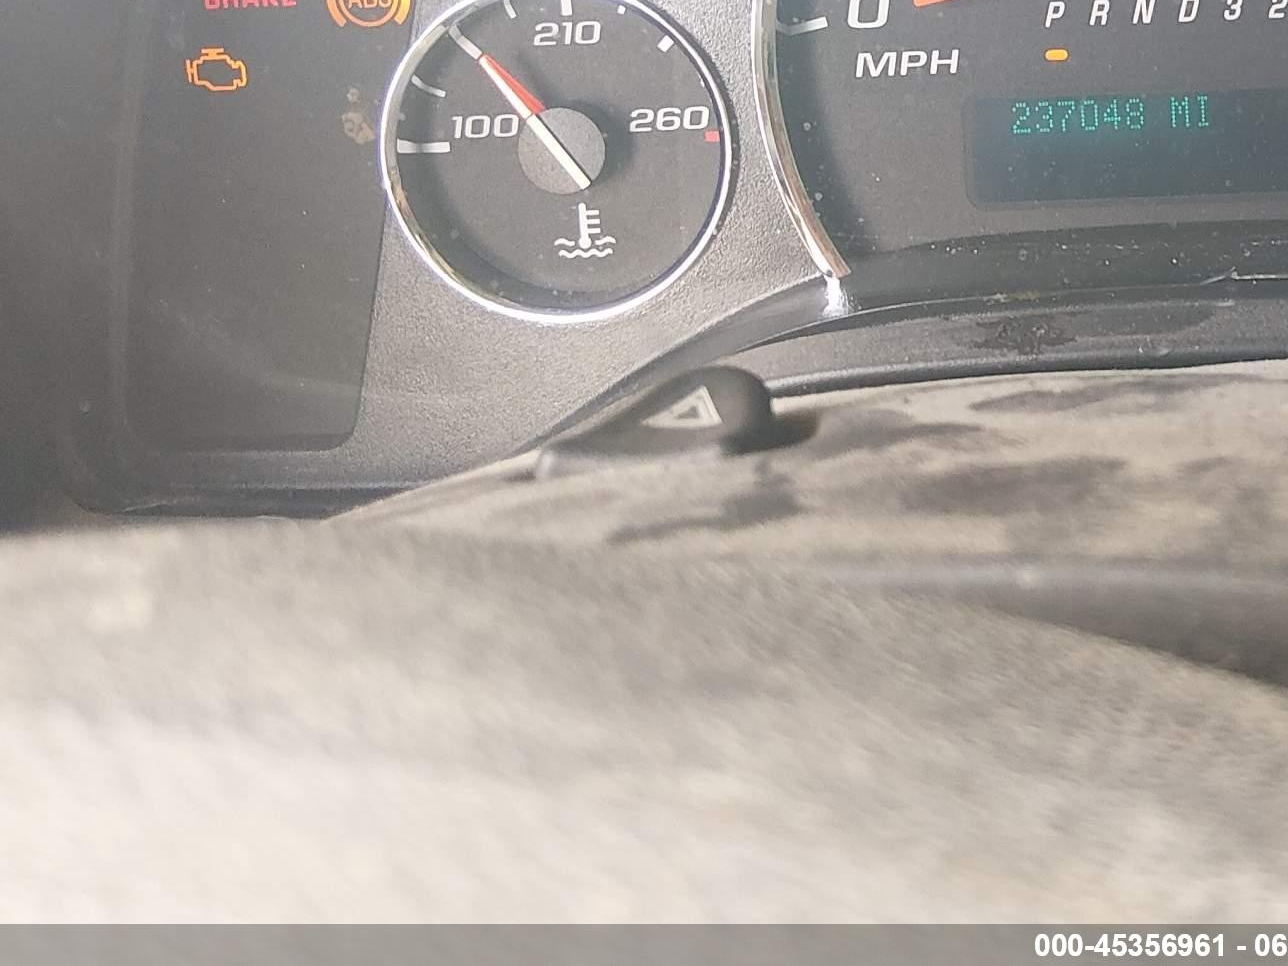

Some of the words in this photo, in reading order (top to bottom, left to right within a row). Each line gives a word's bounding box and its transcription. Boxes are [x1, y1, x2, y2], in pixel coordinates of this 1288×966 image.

[1045, 1, 1066, 27] P
[1089, 0, 1110, 26] R
[534, 22, 601, 46] 210
[855, 49, 960, 78] MPH
[453, 115, 519, 138] 100
[629, 106, 709, 132] 260
[1011, 98, 1144, 134] 237048
[1170, 95, 1209, 128] MI
